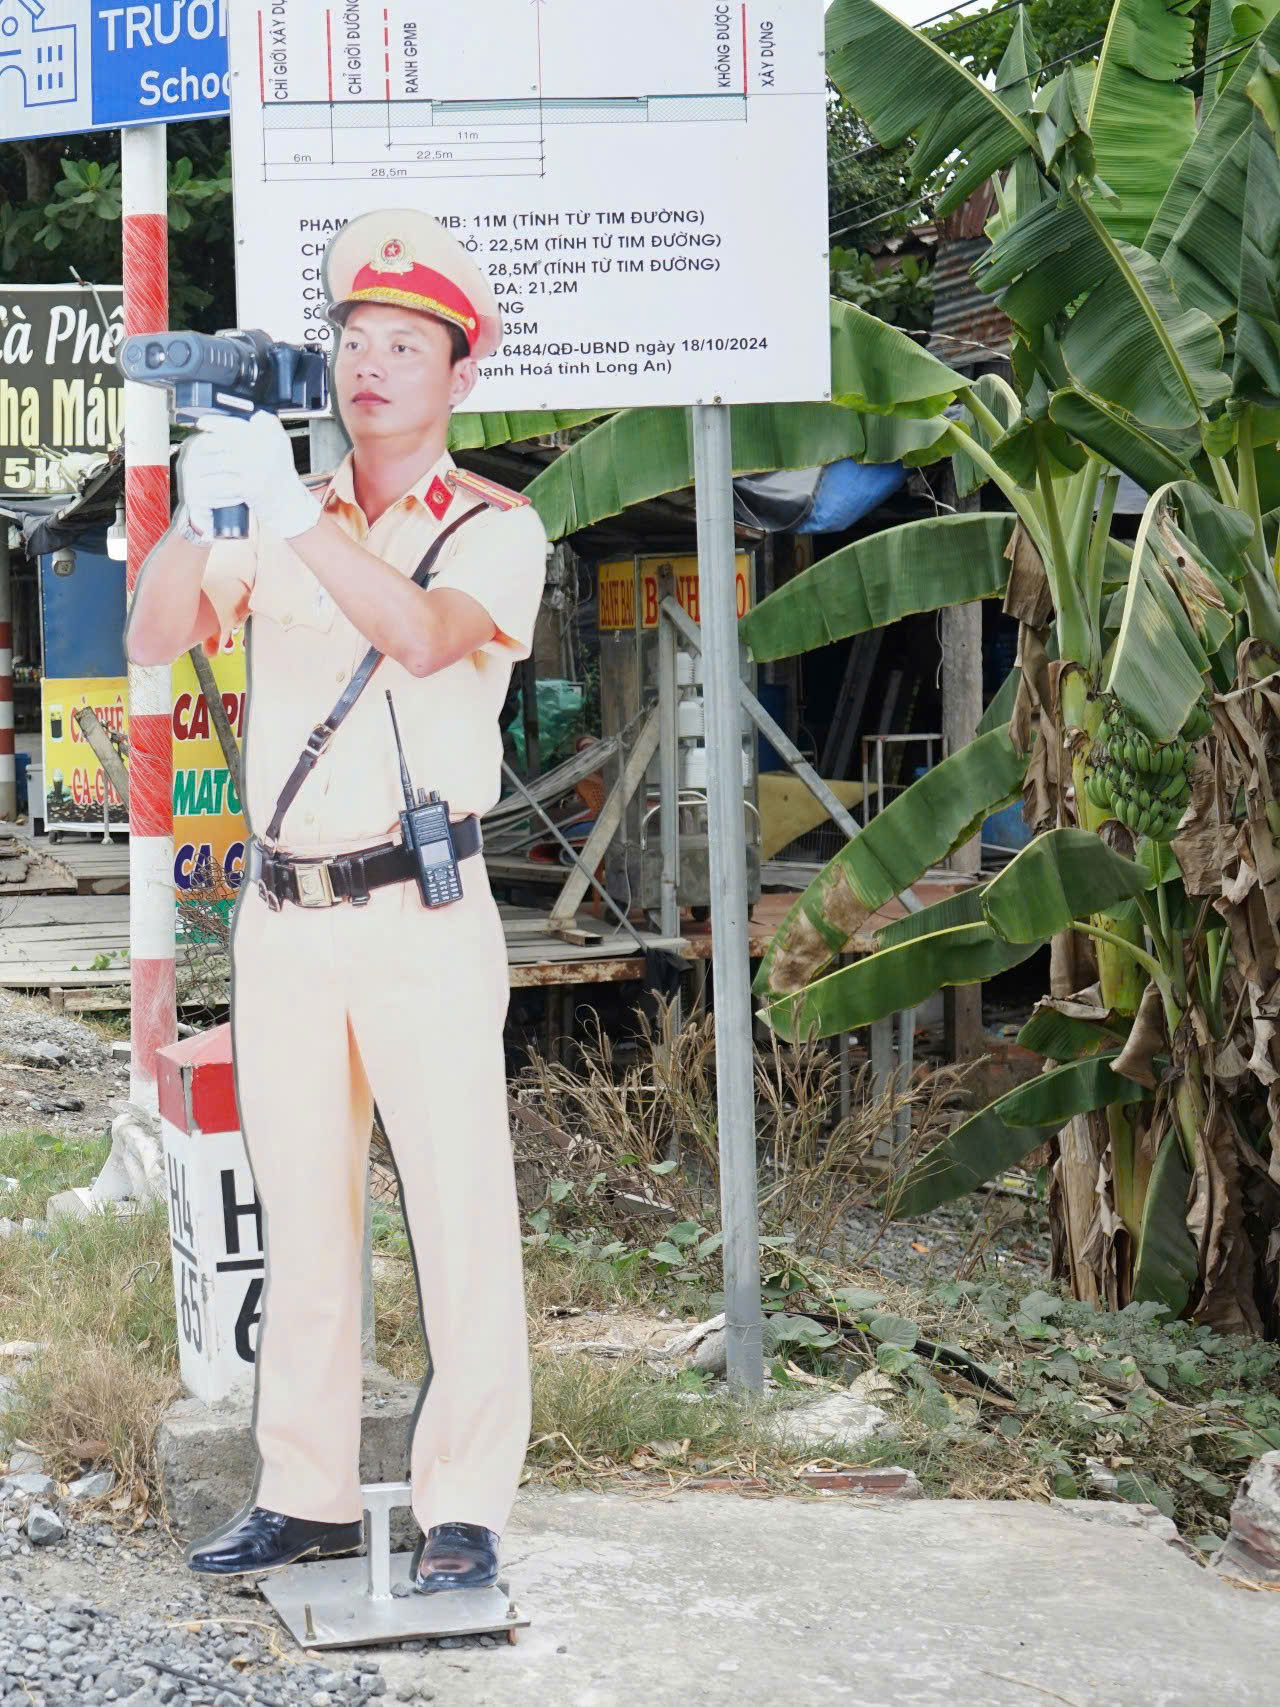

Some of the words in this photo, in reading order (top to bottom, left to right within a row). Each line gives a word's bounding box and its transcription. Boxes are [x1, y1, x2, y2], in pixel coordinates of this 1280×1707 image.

[269, 20, 287, 46] XÂY
[714, 4, 732, 40] ĐƯỢC
[403, 22, 418, 57] GPMB
[759, 21, 776, 57] DỰNG
[405, 61, 419, 94] RANH
[714, 44, 731, 88] KHÔNG
[758, 61, 775, 87] XÂY
[457, 130, 480, 141] 11m
[293, 153, 312, 163] 6m
[370, 167, 408, 178] 28,5m
[473, 215, 507, 228] 11M
[513, 211, 560, 230] (TÍNH
[565, 209, 591, 225] TỪ
[596, 212, 626, 225] TIM
[630, 208, 706, 226] ĐƯỜNG)
[489, 237, 539, 253] 22,5M
[544, 234, 587, 253] (TÍNH
[592, 232, 613, 249] TỪ
[618, 235, 646, 248] TIM
[651, 231, 722, 248] ĐƯỜNG)
[488, 261, 538, 277] 28,5M
[544, 258, 586, 277] (TÍNH
[591, 257, 612, 273] TỪ
[617, 259, 645, 273] TIM
[650, 255, 721, 272] ĐƯỜNG)
[493, 282, 522, 296] ĐA:
[528, 281, 578, 295] 21,2M
[45, 304, 124, 365] Phê
[503, 341, 630, 357] 6484/QĐ-UBND
[635, 339, 676, 356] ngày
[681, 337, 768, 352] 18/10/2024
[520, 362, 553, 377] Hoá
[558, 360, 590, 375] tỉnh
[596, 360, 638, 376] Long
[643, 359, 672, 376] An)
[52, 373, 125, 449] Máy
